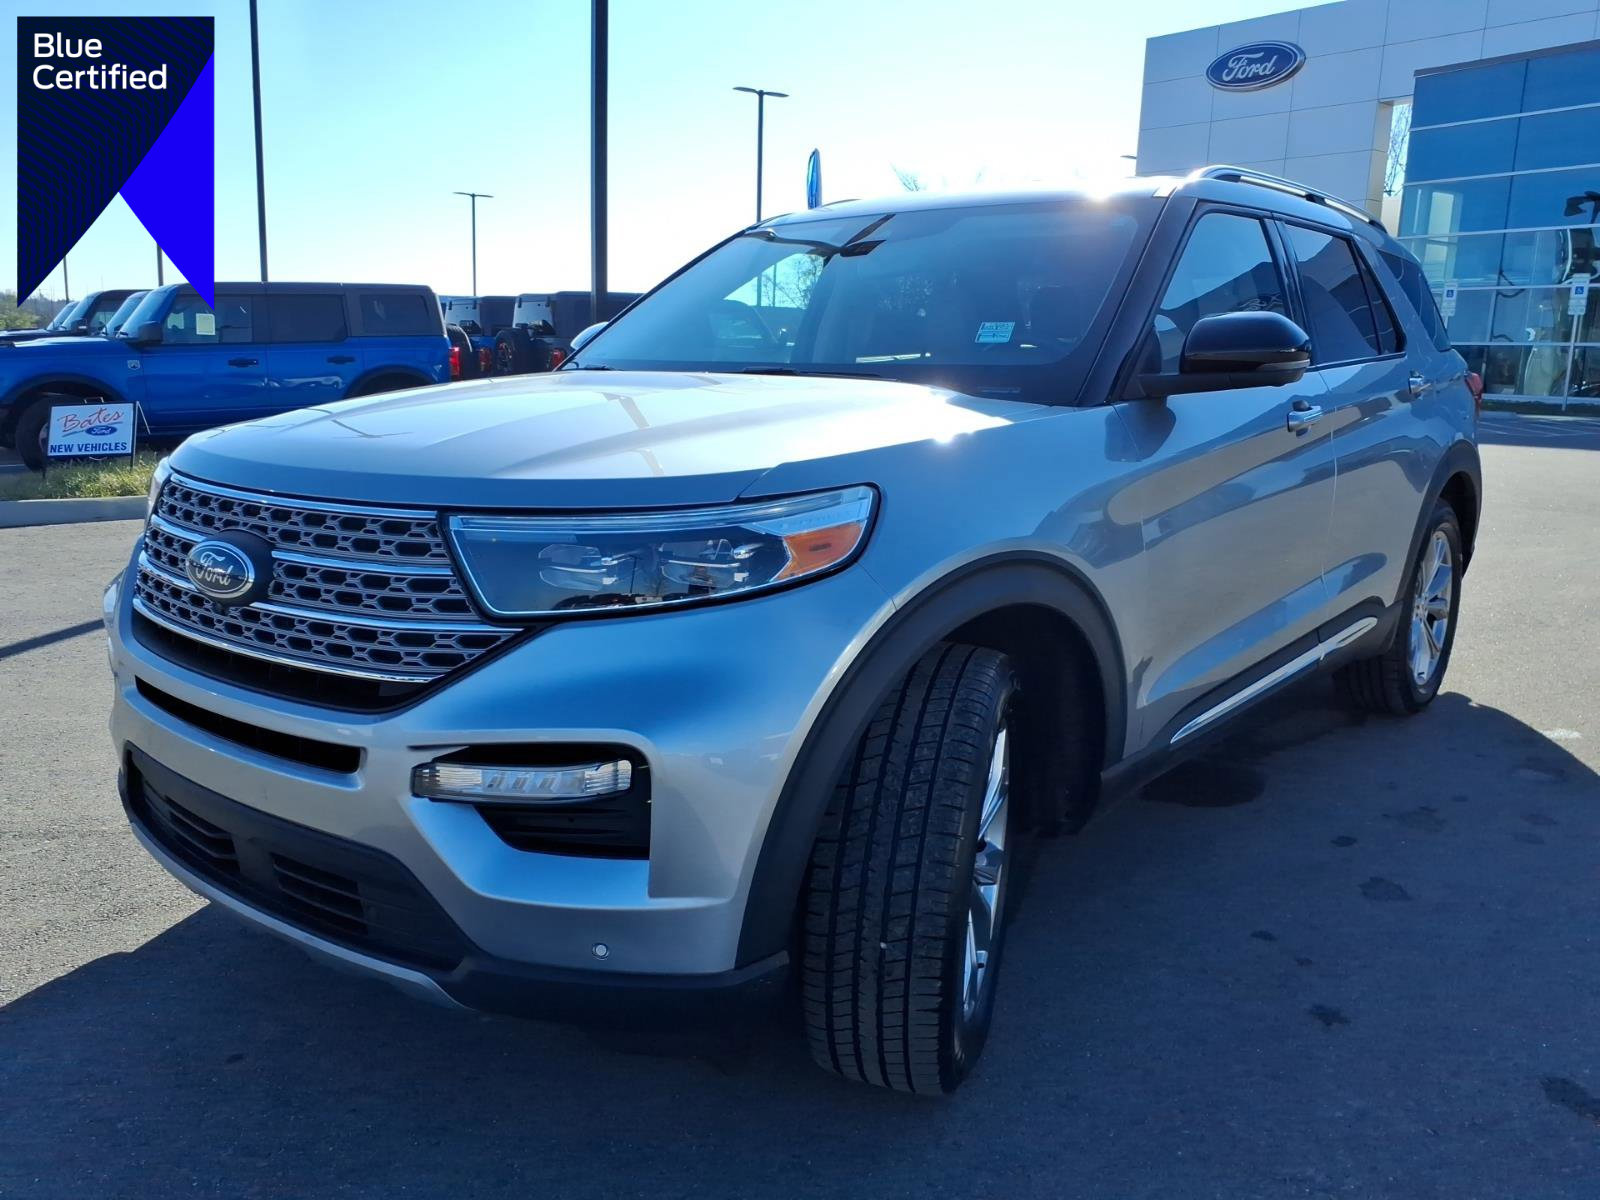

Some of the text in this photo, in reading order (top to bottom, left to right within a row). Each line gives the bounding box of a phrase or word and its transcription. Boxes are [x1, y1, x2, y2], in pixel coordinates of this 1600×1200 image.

[1222, 52, 1279, 82] Ford
[57, 407, 124, 433] Bates
[49, 442, 127, 453] NEW VEHICLES
[193, 551, 234, 586] Ford
